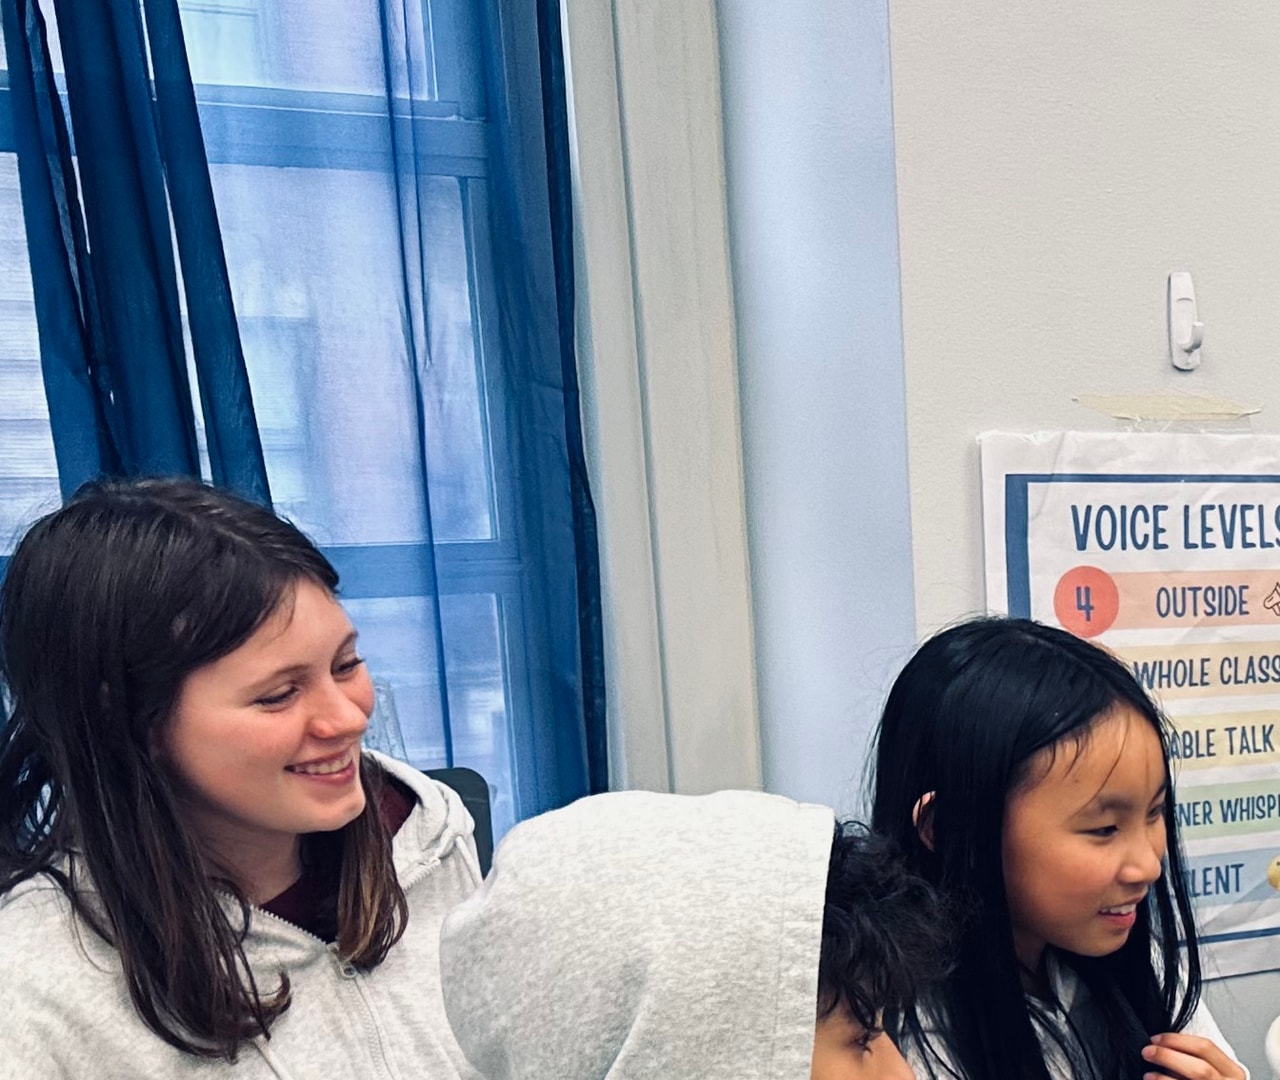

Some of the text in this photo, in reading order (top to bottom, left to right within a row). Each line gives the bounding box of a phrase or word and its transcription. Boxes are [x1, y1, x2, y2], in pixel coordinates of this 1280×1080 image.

[1070, 504, 1169, 552] VOICE
[1076, 585, 1250, 622] 4 OUTSIDE
[1134, 657, 1211, 689] WHOLE
[1170, 724, 1276, 760] ABLE TALK
[1177, 800, 1213, 828] NER
[1190, 863, 1245, 898] LENT
